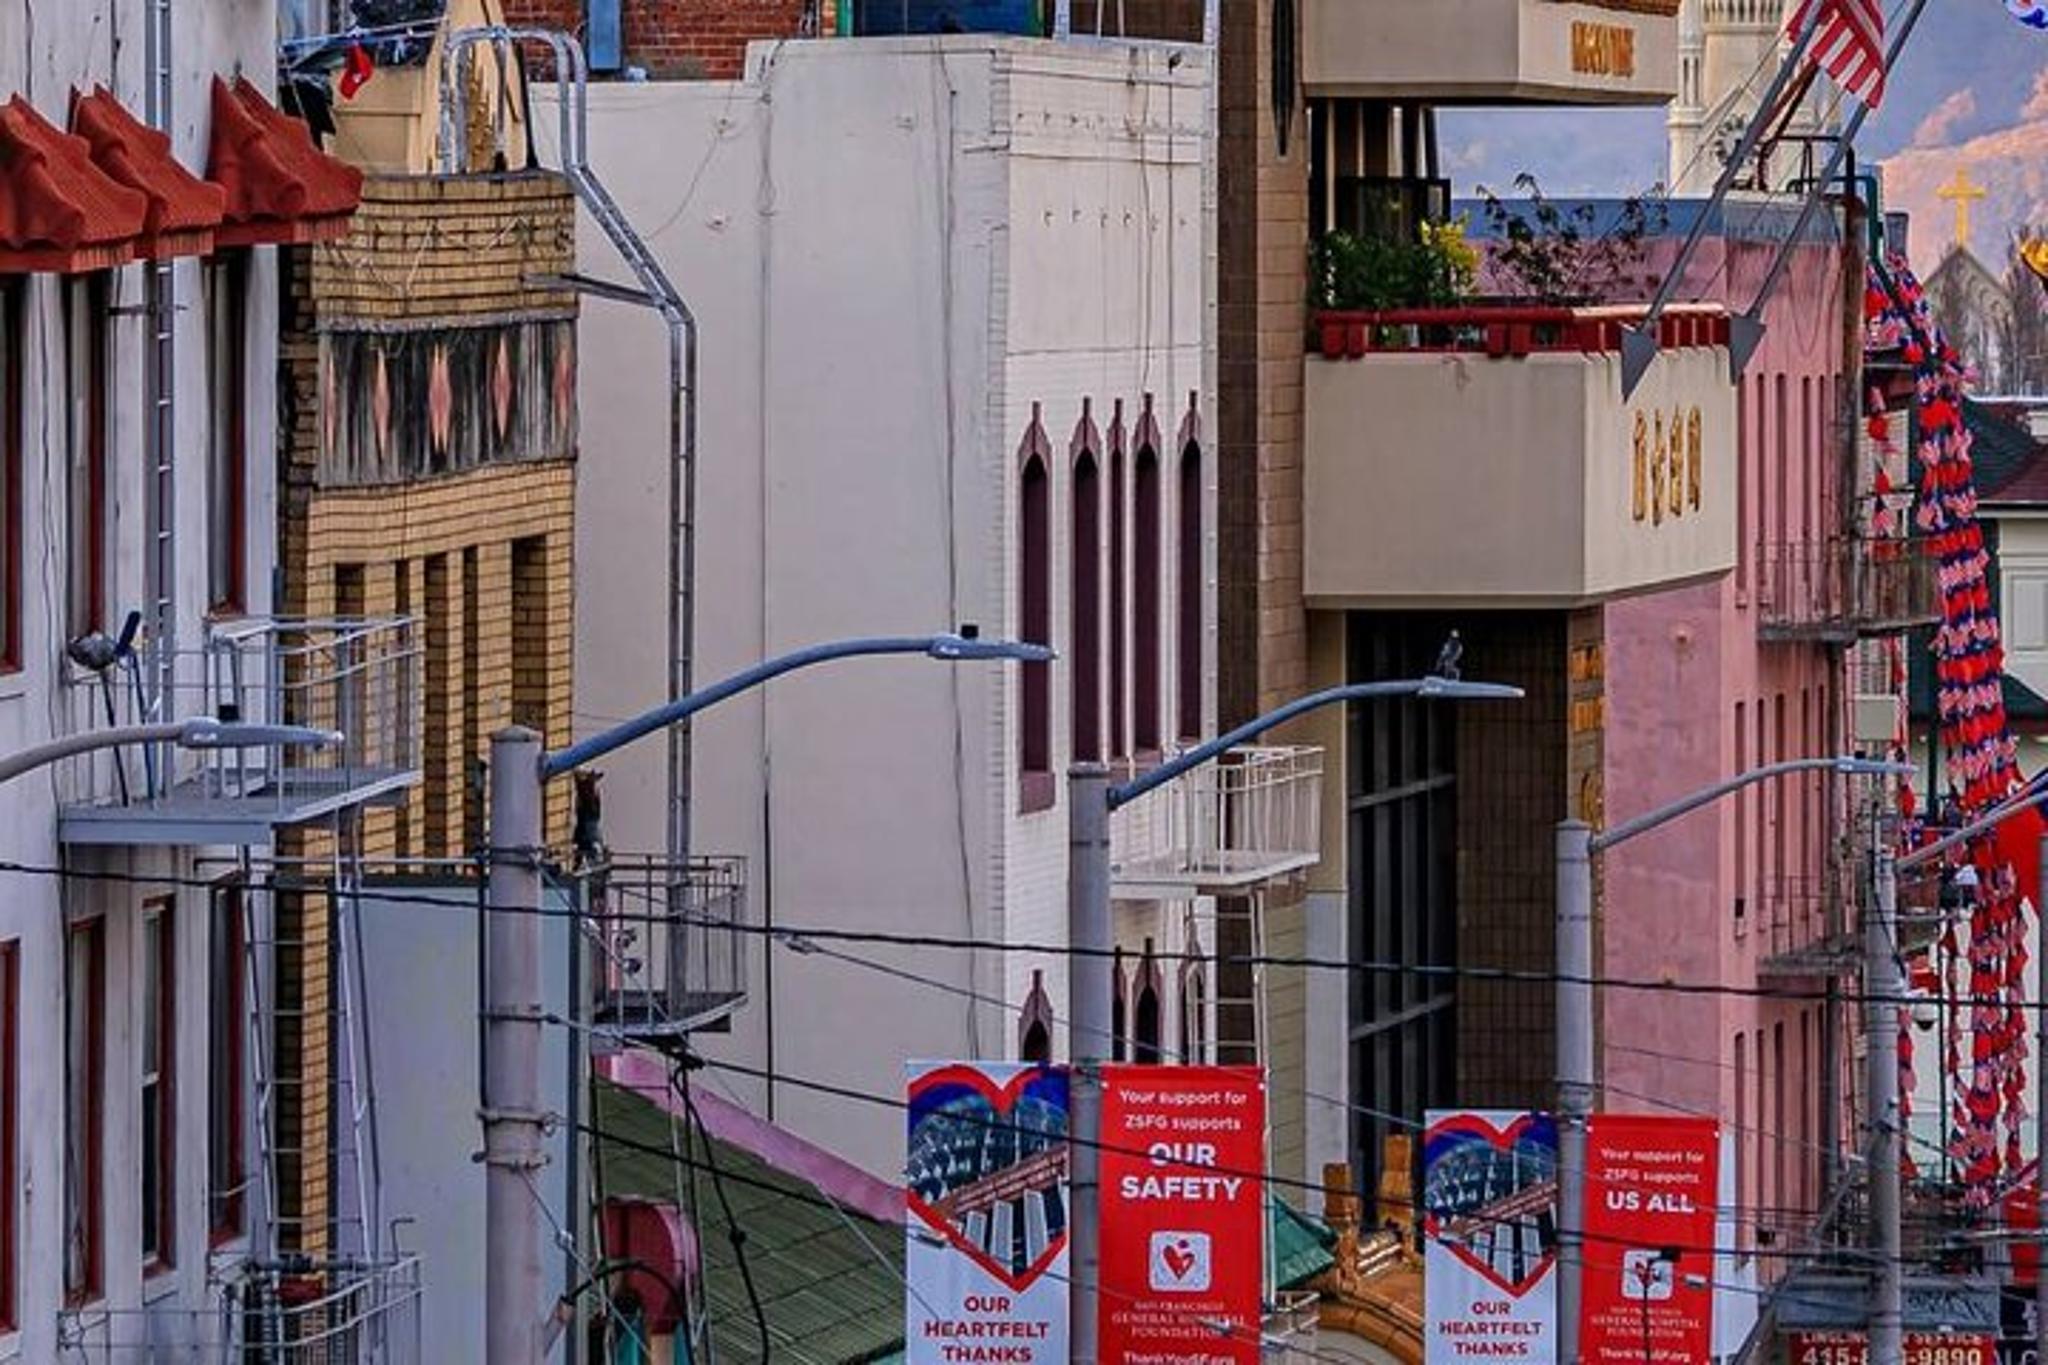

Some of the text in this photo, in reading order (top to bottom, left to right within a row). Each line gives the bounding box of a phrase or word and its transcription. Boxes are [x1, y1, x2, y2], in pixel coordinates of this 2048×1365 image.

[1119, 1089, 1248, 1107] Your support for
[1171, 1116, 1241, 1132] supports
[1149, 1142, 1216, 1167] OUR
[1600, 1148, 1704, 1163] Your support for
[1120, 1176, 1243, 1201] SAFETY
[1606, 1190, 1697, 1213] US ALL
[963, 1296, 1011, 1312] OUR
[1472, 1301, 1511, 1315] OUR
[924, 1321, 1049, 1338] HEARTFELT
[1439, 1321, 1542, 1334] HEARTFELT
[941, 1345, 1033, 1362] THANKS
[1454, 1342, 1528, 1355] THANKS
